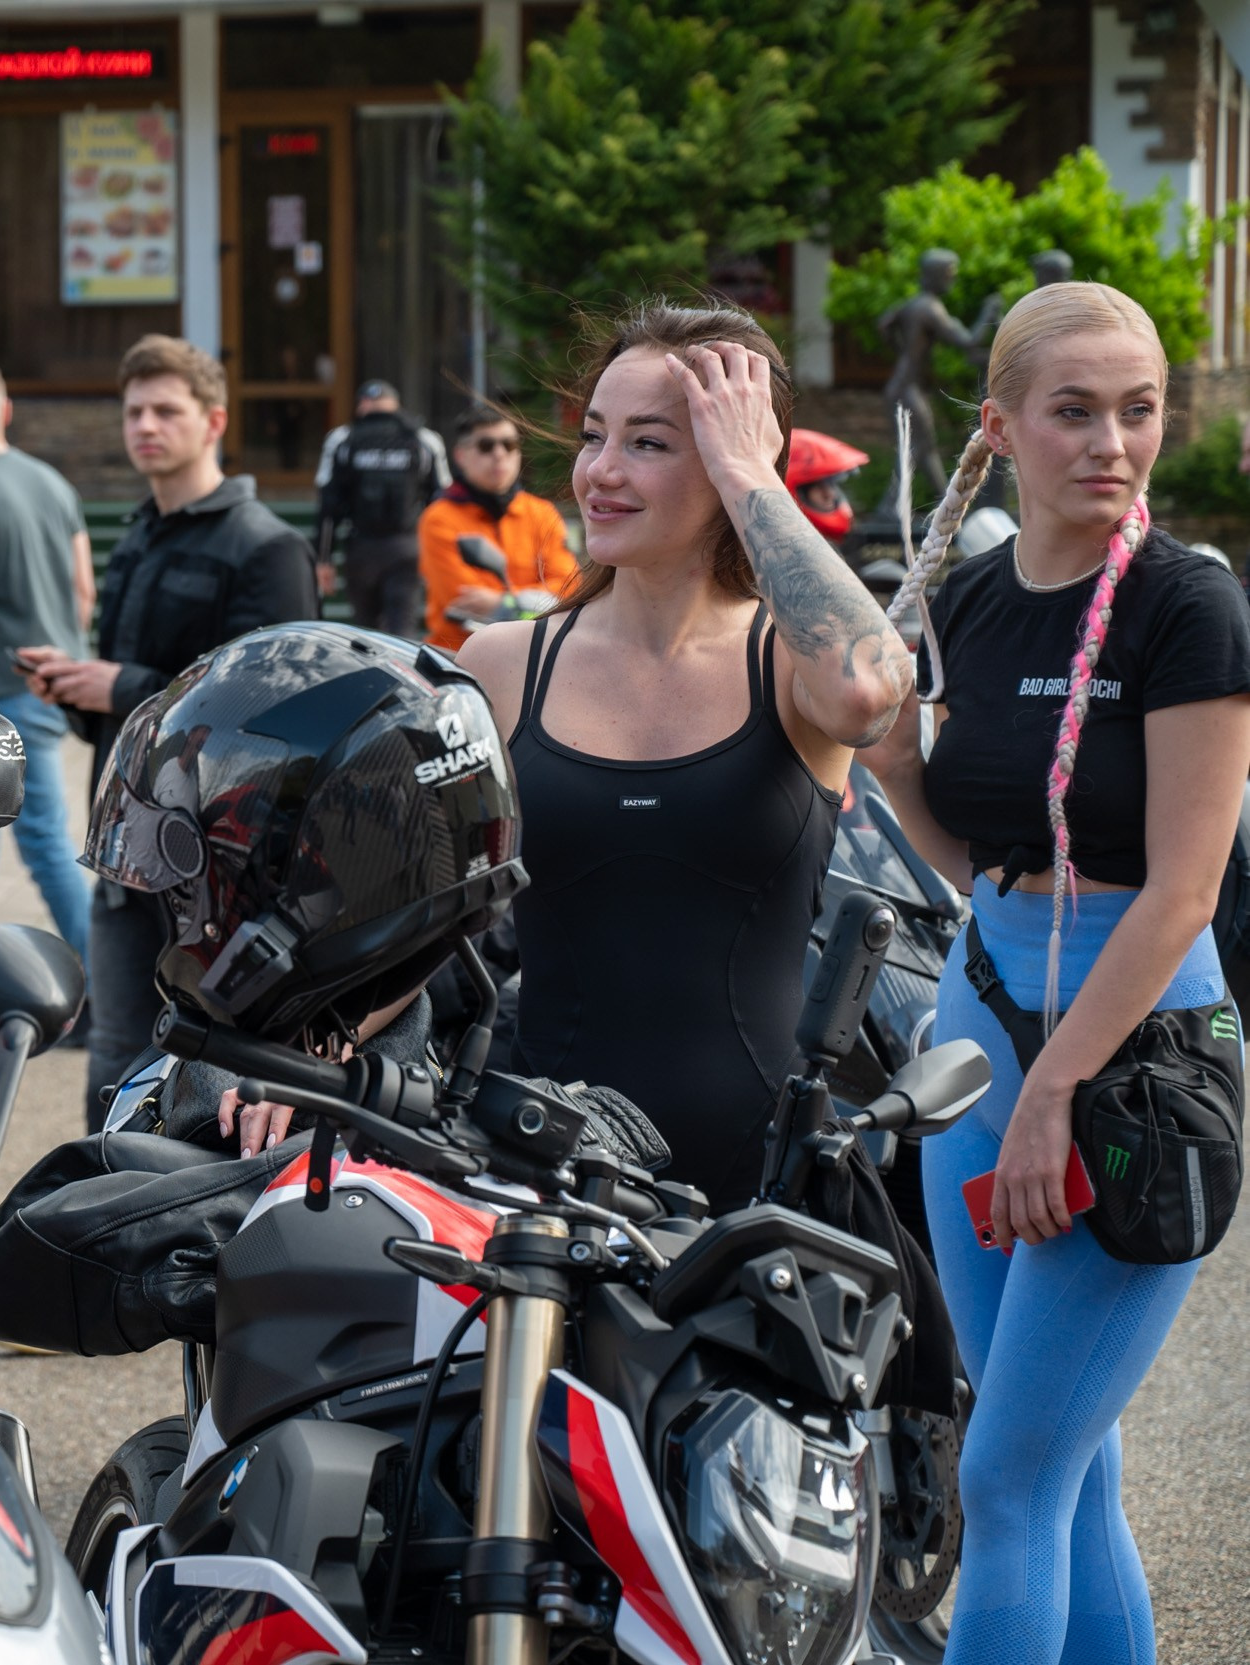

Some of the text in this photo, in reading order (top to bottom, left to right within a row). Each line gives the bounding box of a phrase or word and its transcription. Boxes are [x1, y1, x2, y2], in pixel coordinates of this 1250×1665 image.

[1019, 678, 1122, 700] BAD GIRL OCHI
[414, 735, 494, 784] SHARK
